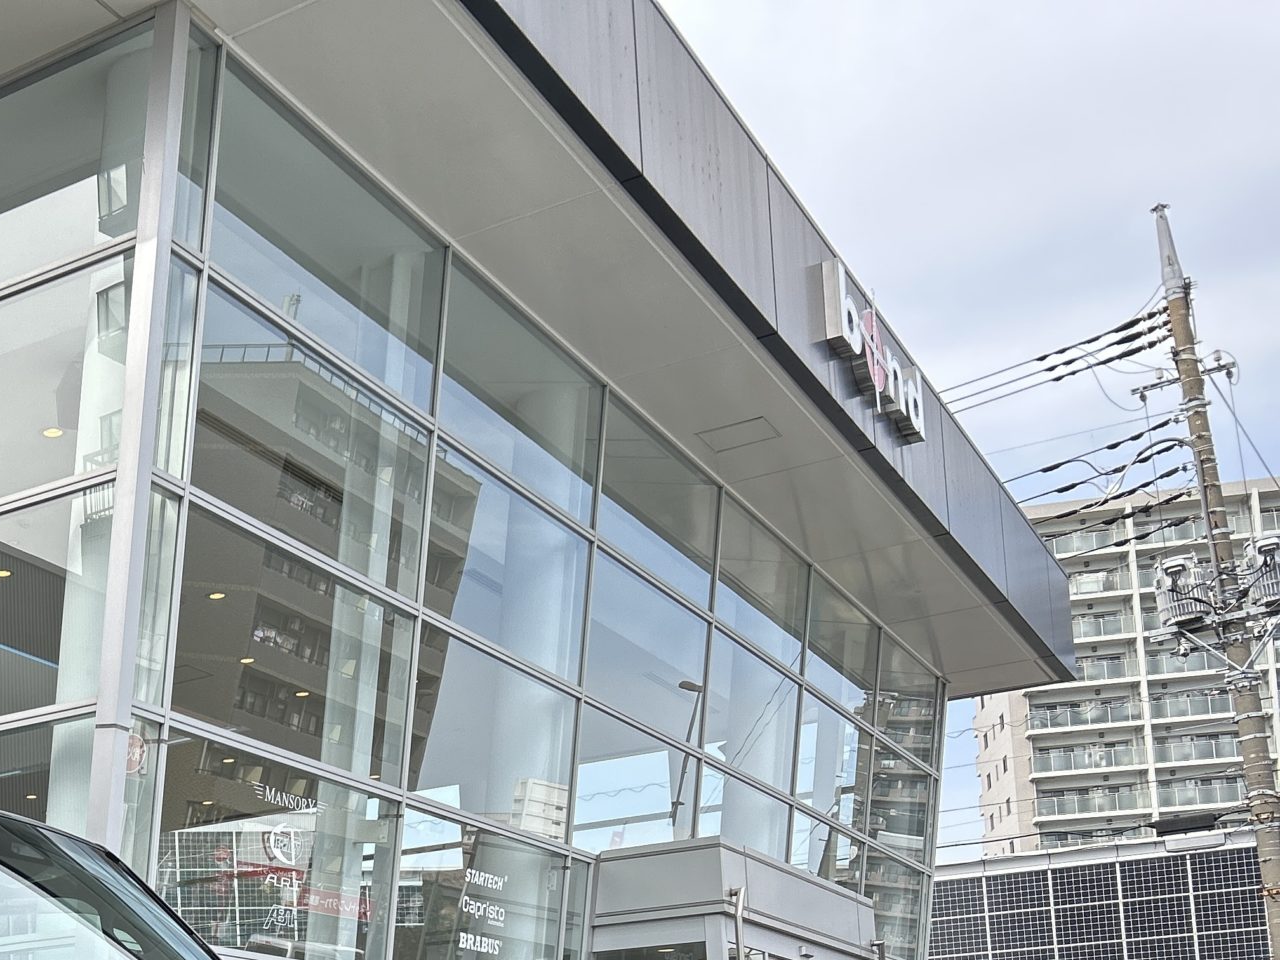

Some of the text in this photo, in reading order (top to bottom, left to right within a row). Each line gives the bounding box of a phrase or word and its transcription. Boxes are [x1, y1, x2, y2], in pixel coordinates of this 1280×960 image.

[264, 785, 317, 814] MANSORY
[464, 868, 504, 891] STARTECH
[462, 895, 505, 921] Capristo
[458, 931, 501, 955] BRABUS
